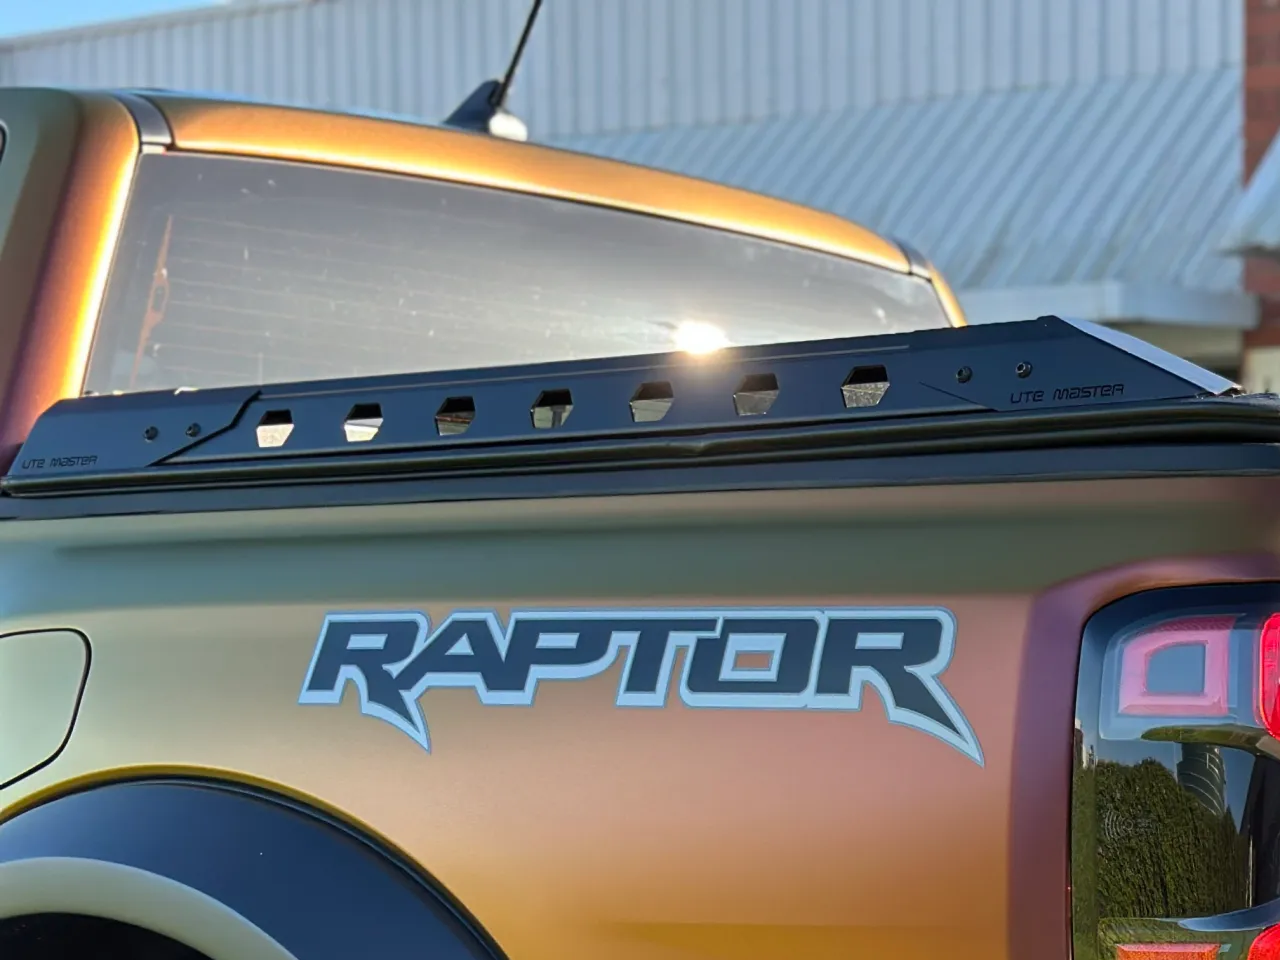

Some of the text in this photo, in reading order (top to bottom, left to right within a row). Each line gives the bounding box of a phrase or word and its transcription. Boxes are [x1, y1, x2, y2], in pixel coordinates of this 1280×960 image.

[1010, 383, 1124, 404] UTE MASTER
[22, 455, 98, 470] UTE MASTER
[299, 606, 985, 768] RAPTOR
